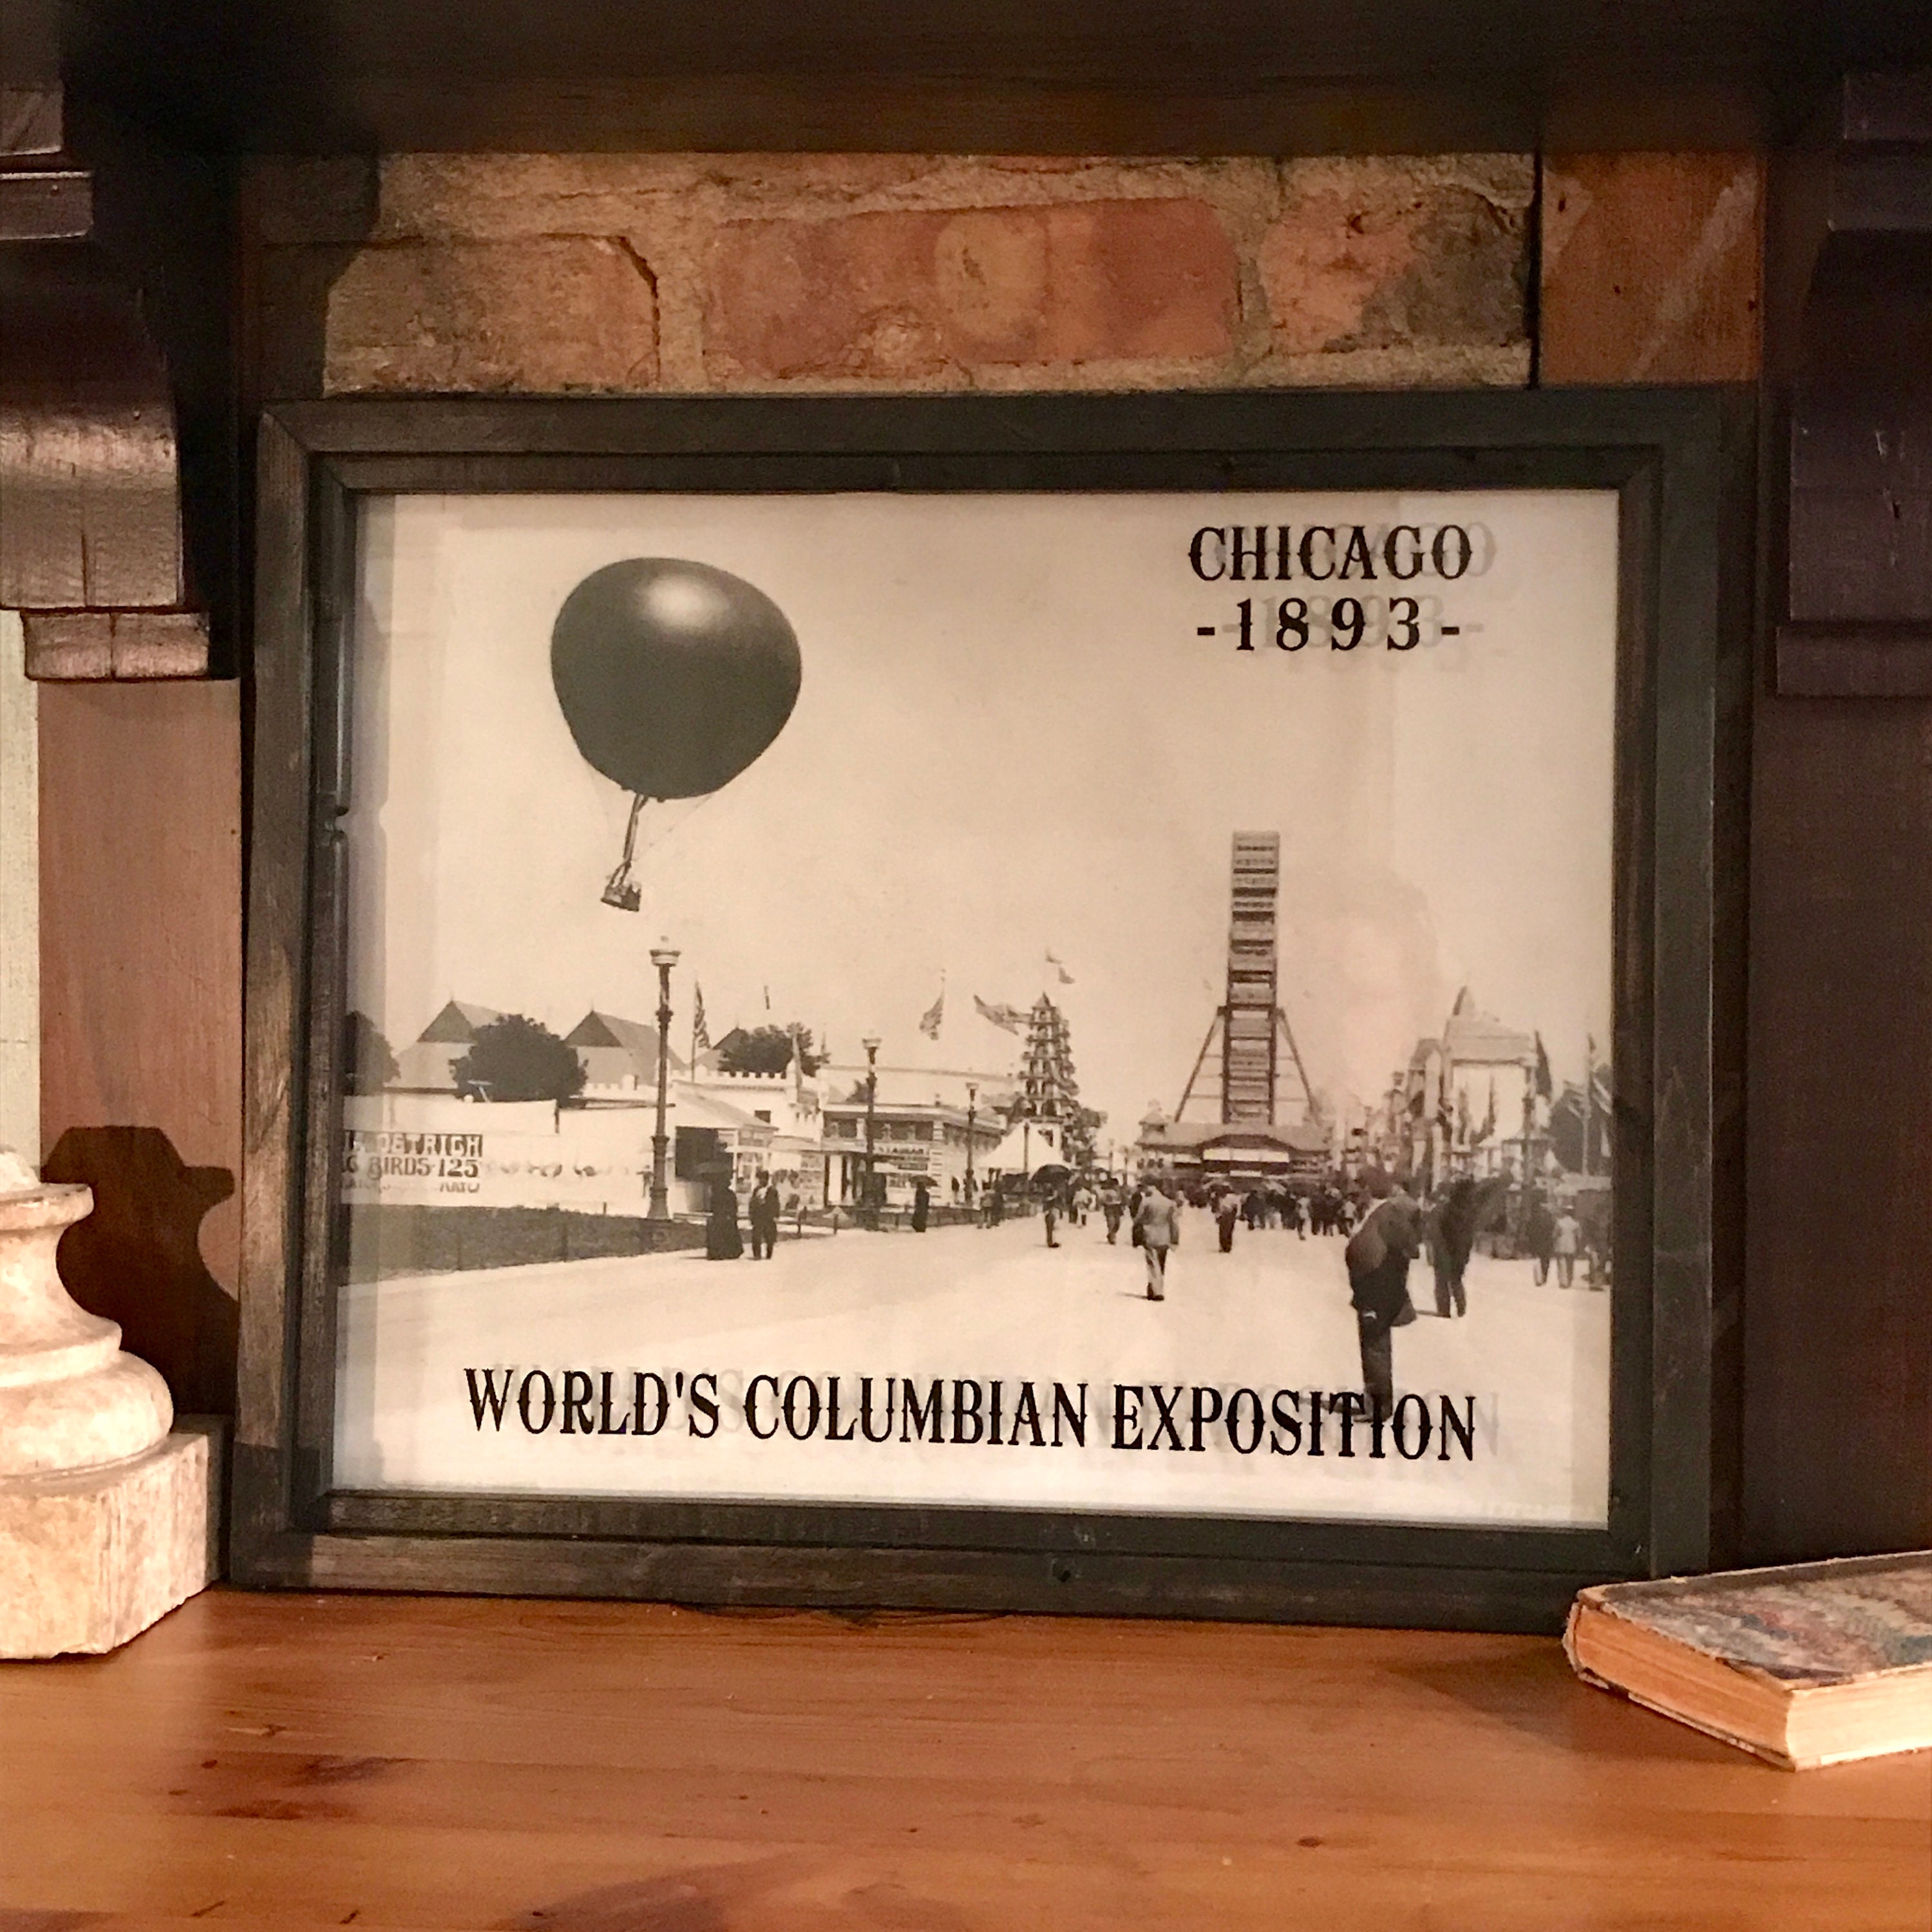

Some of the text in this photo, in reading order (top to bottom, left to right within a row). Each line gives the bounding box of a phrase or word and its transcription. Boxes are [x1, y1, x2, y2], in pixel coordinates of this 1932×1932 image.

[1188, 524, 1473, 582] CHICAGO
[464, 1368, 1476, 1461] WORLD'S COLUMBIAN EXPOSITION
